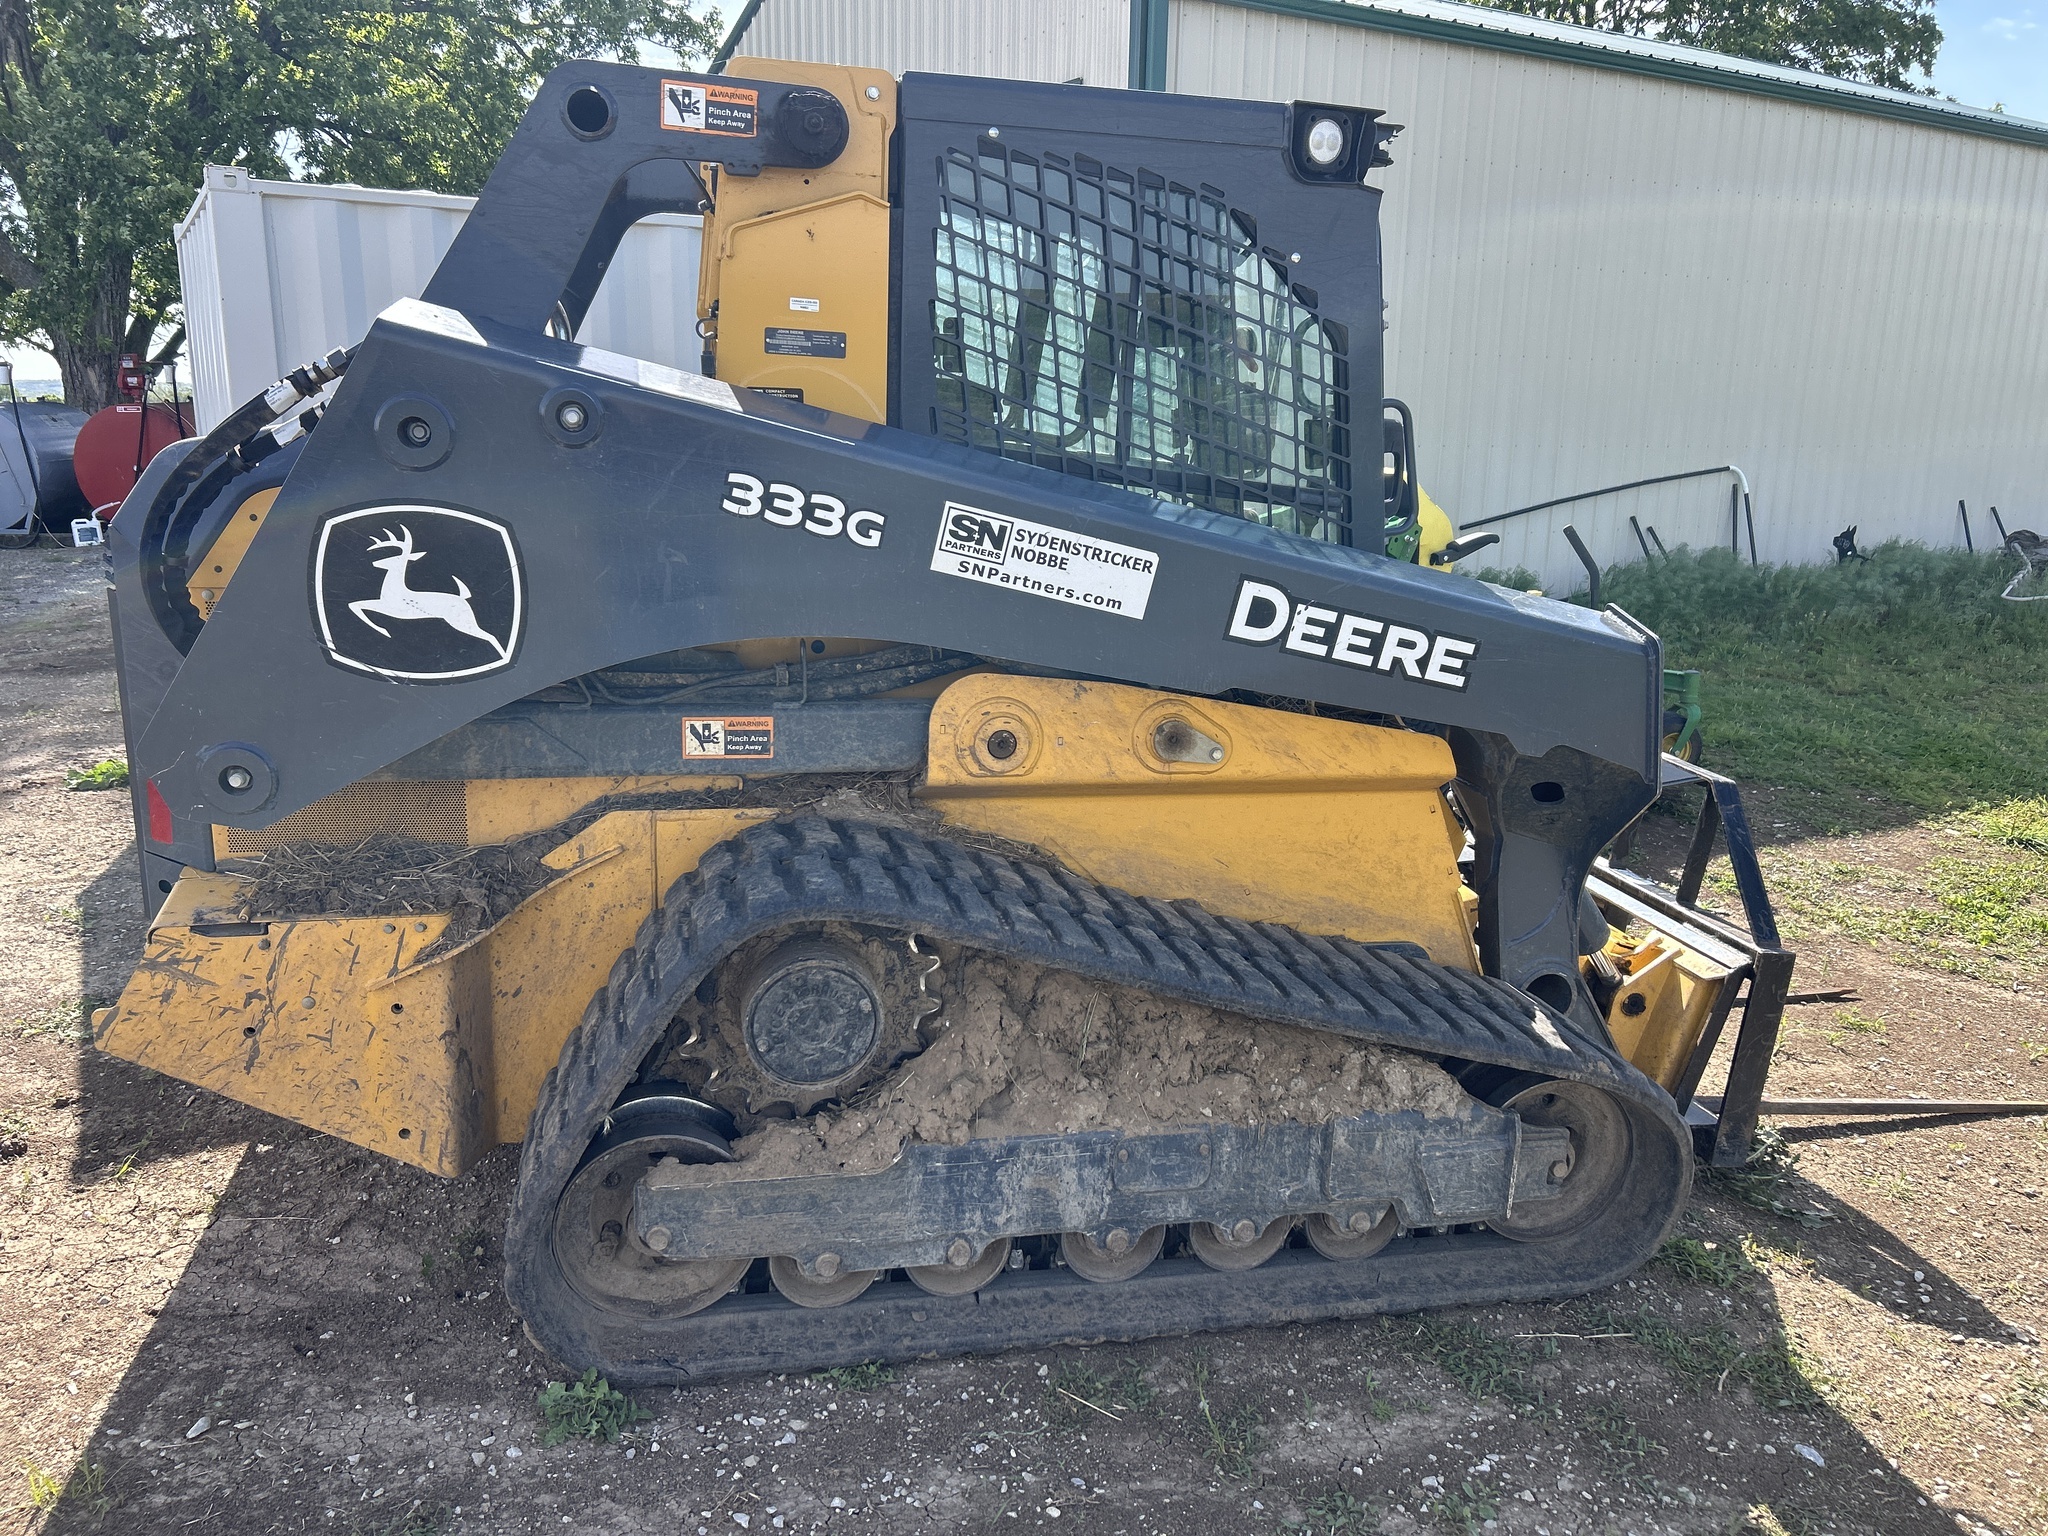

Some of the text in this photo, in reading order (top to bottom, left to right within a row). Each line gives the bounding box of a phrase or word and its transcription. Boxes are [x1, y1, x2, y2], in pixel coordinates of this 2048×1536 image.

[718, 91, 753, 101] WARNING
[708, 107, 752, 119] Pinch Area
[708, 117, 746, 129] Keep Away
[722, 472, 885, 547] 333G
[945, 540, 1002, 561] PARTNERS
[1010, 545, 1070, 571] NOBBE
[1014, 528, 1154, 575] SYDENSTRICKER
[957, 560, 1123, 611] SNPartners.com
[1228, 579, 1476, 688] DEERE
